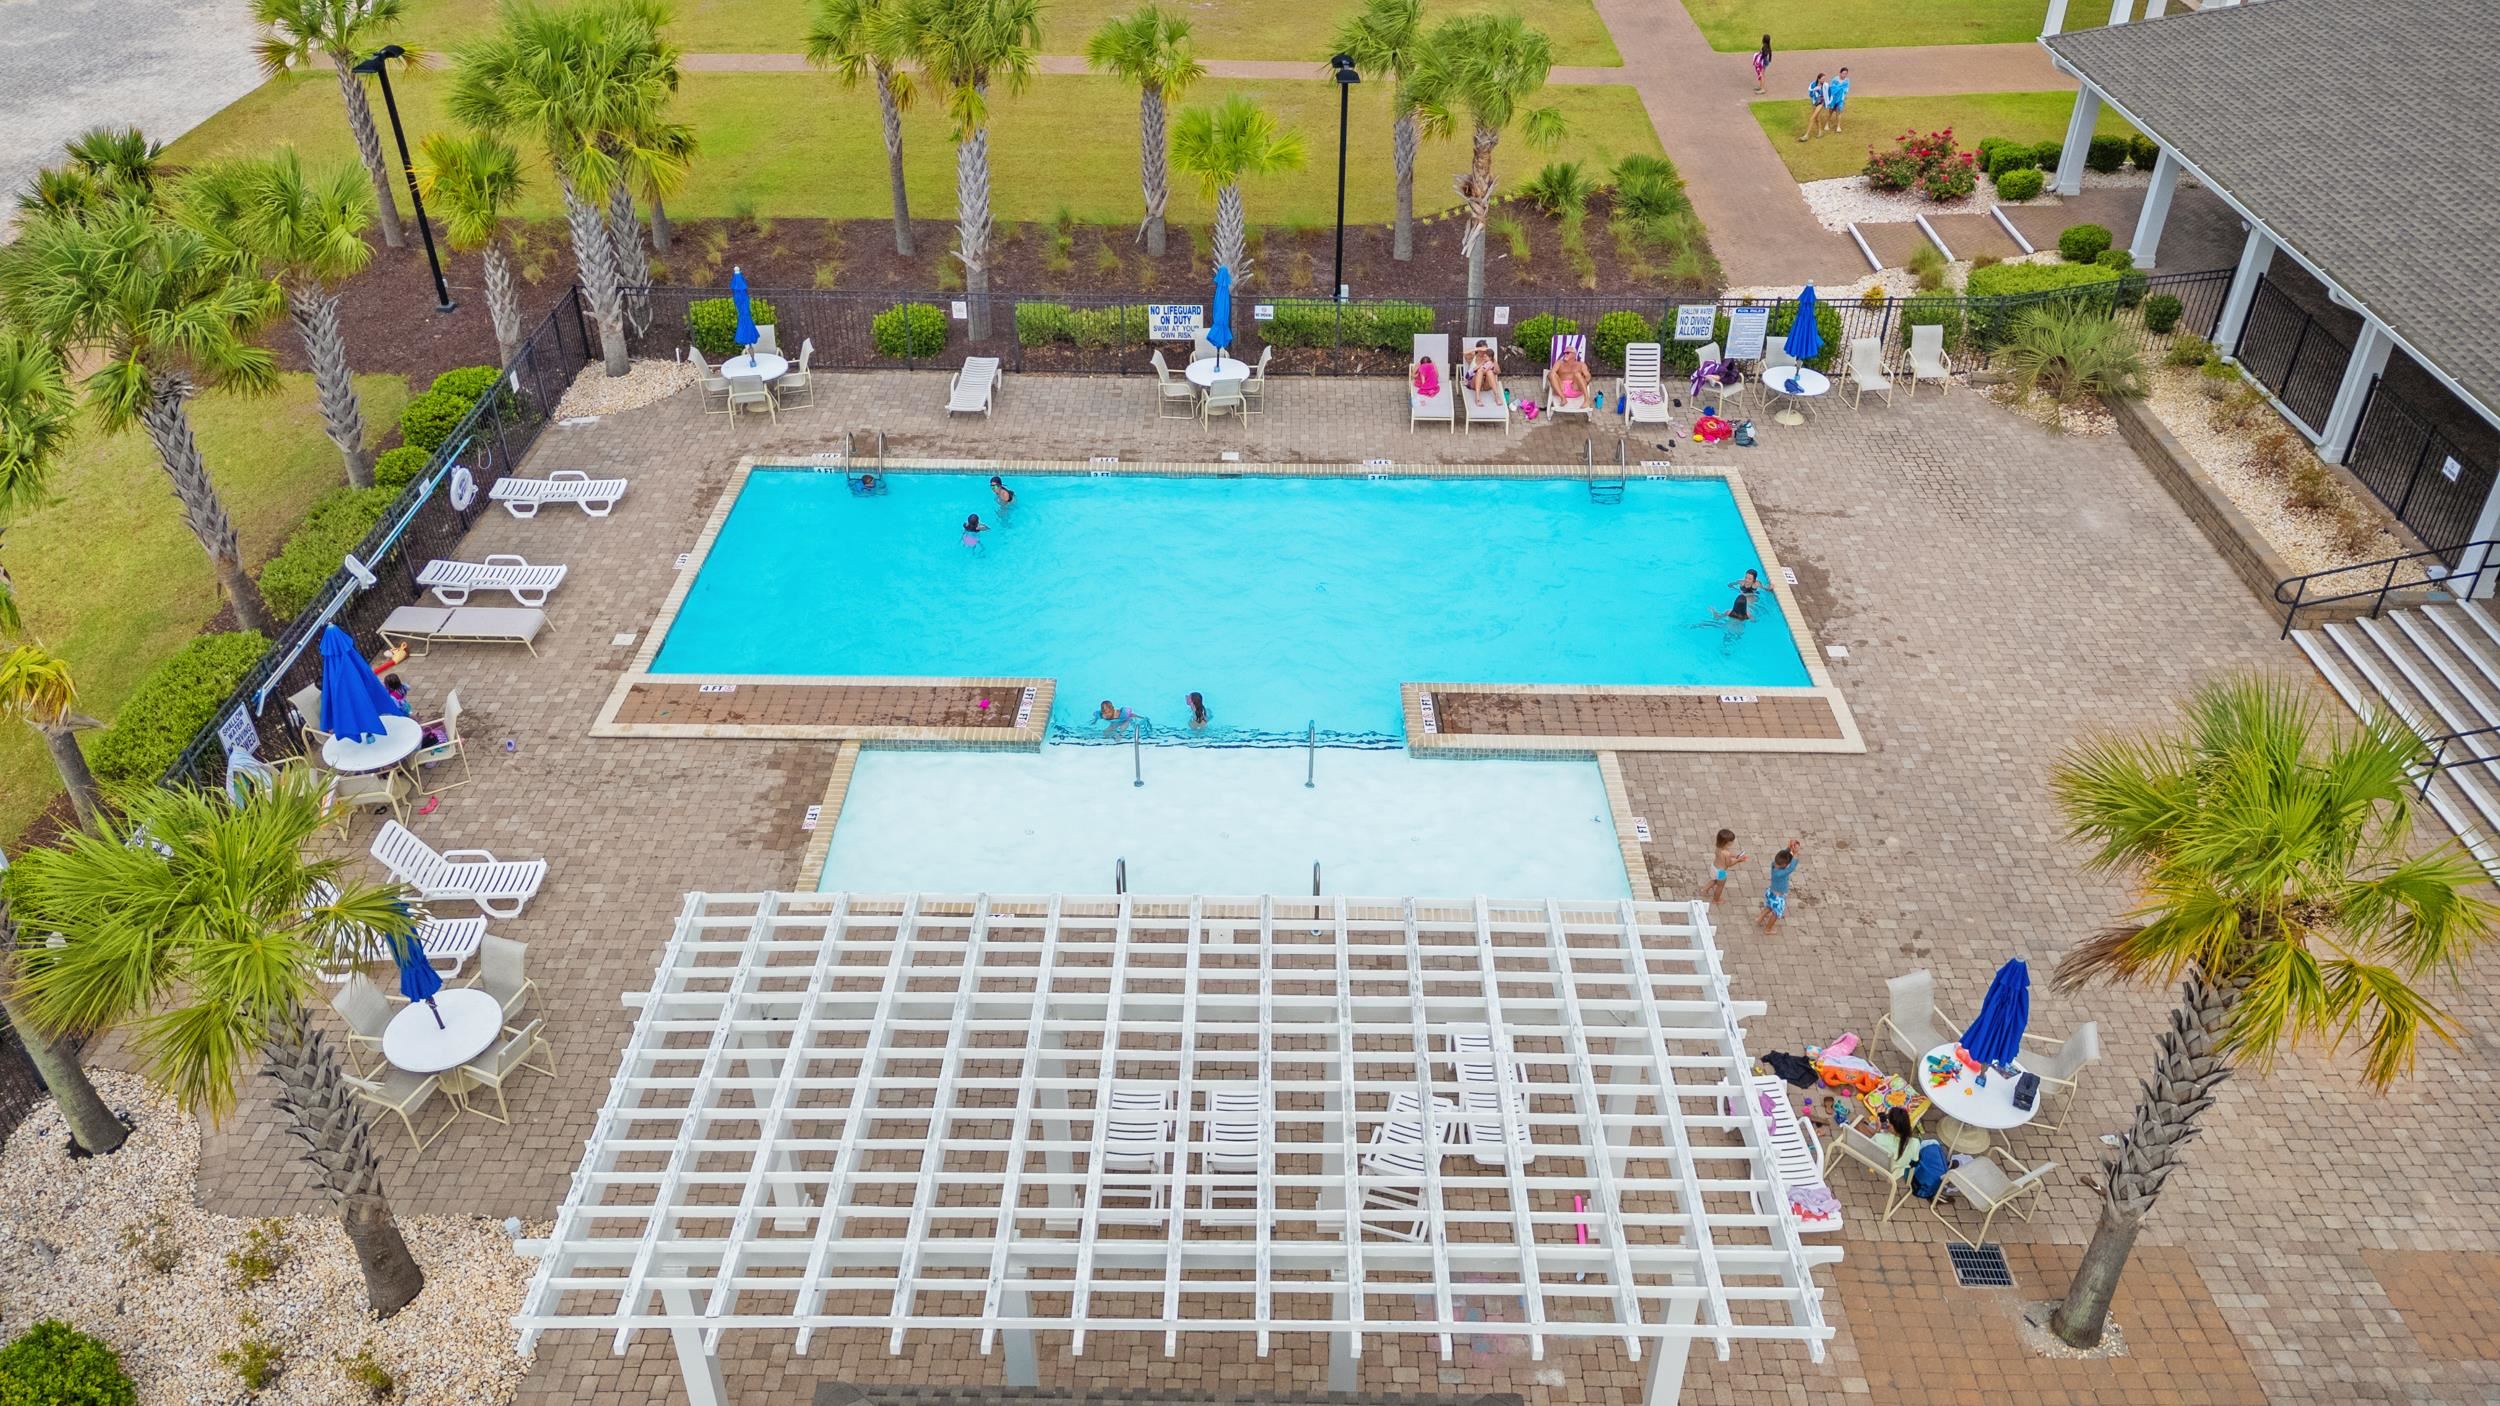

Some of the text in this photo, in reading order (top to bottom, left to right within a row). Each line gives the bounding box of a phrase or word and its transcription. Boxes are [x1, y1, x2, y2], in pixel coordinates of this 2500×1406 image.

[1150, 305, 1202, 315] NO LIFEGUARD
[1160, 316, 1192, 325] ON DUTY
[1680, 316, 1711, 326] NO DIVING
[1679, 326, 1709, 336] ALLOWED
[222, 708, 244, 737] SHALLOW
[228, 719, 245, 740] WATER
[235, 723, 252, 746] DIVING
[1637, 825, 1648, 833] FT
